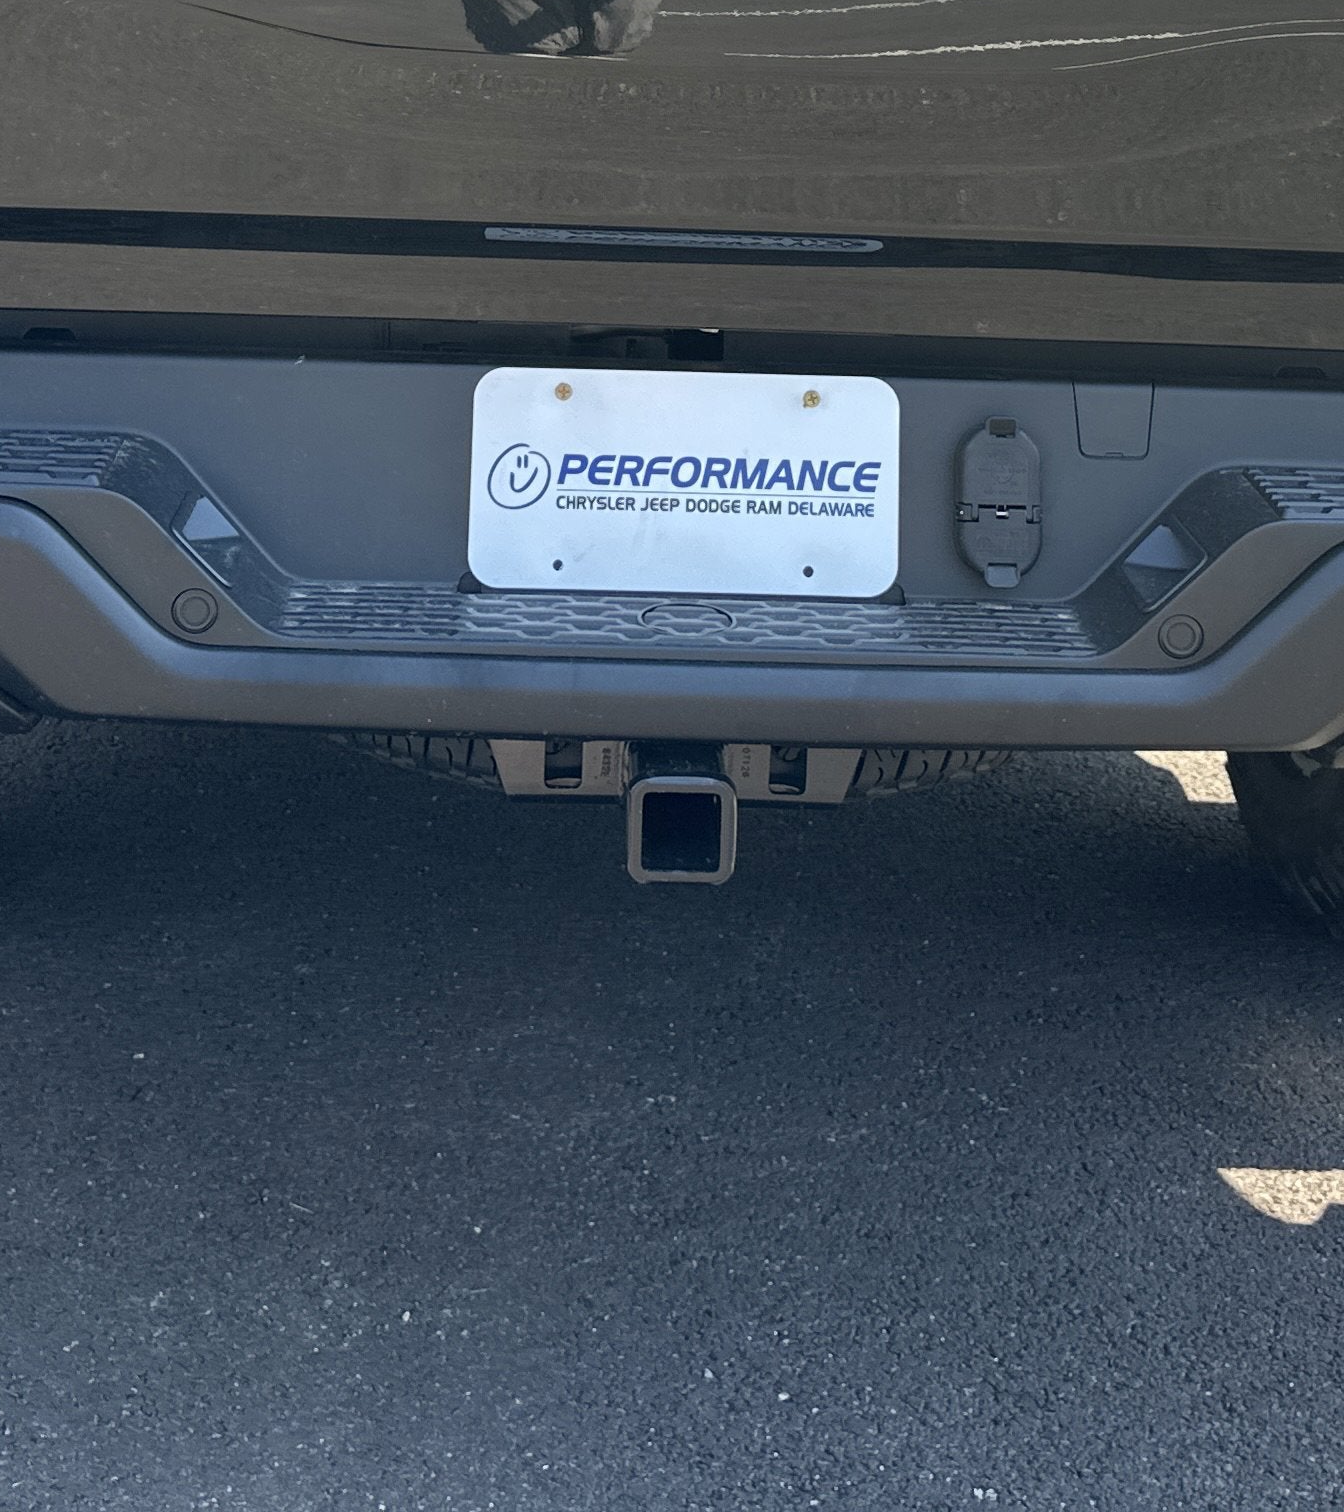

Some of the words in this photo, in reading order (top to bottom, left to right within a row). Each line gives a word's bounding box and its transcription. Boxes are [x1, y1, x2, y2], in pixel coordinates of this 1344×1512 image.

[557, 454, 882, 492] PERFORMANCE
[556, 495, 636, 512] CHRYSLER
[640, 497, 680, 513] JEEP
[685, 499, 741, 515] DODGE
[746, 500, 783, 516] RAM
[787, 501, 875, 518] DELAWARE
